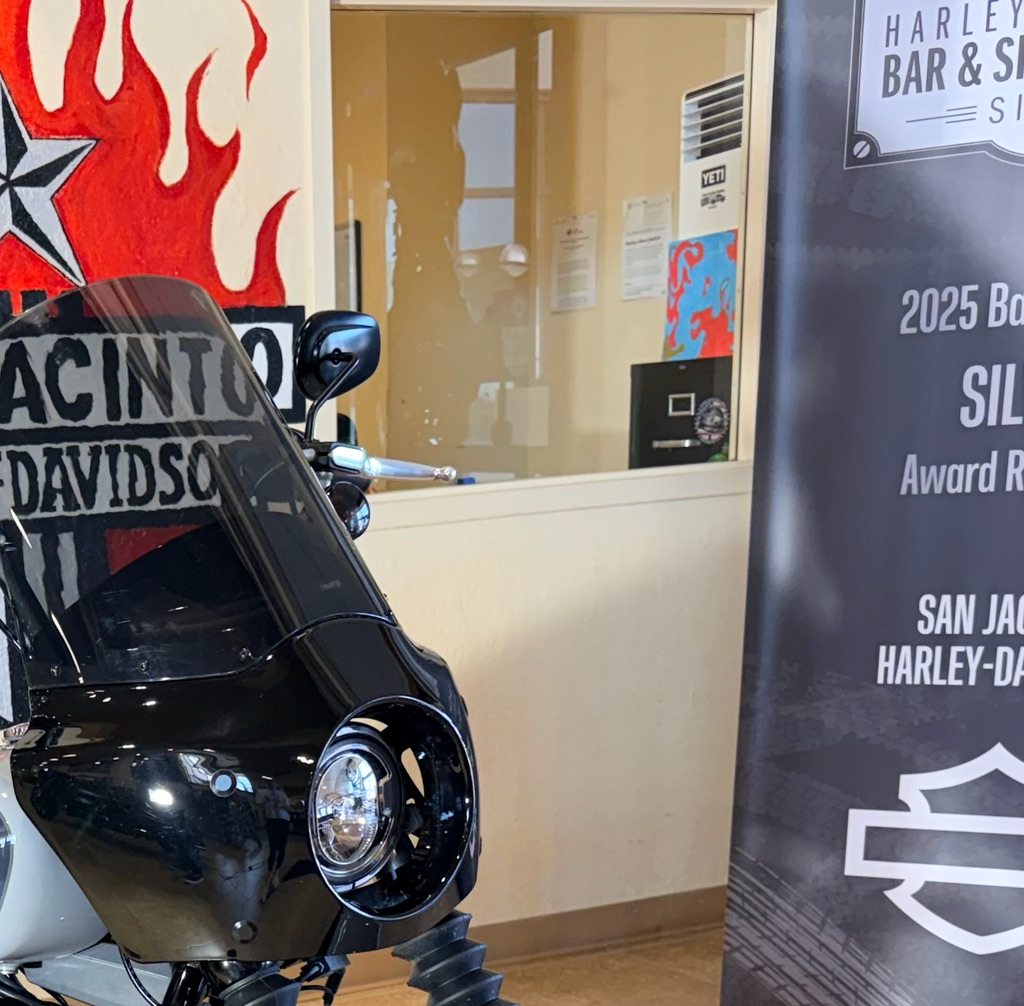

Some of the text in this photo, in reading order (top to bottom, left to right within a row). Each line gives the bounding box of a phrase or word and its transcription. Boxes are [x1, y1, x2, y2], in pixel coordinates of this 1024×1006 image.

[882, 47, 947, 99] BAR
[958, 41, 983, 88] &
[702, 167, 725, 186] YETI
[899, 284, 979, 335] 2025
[899, 450, 998, 496] Award
[917, 593, 976, 635] SAN
